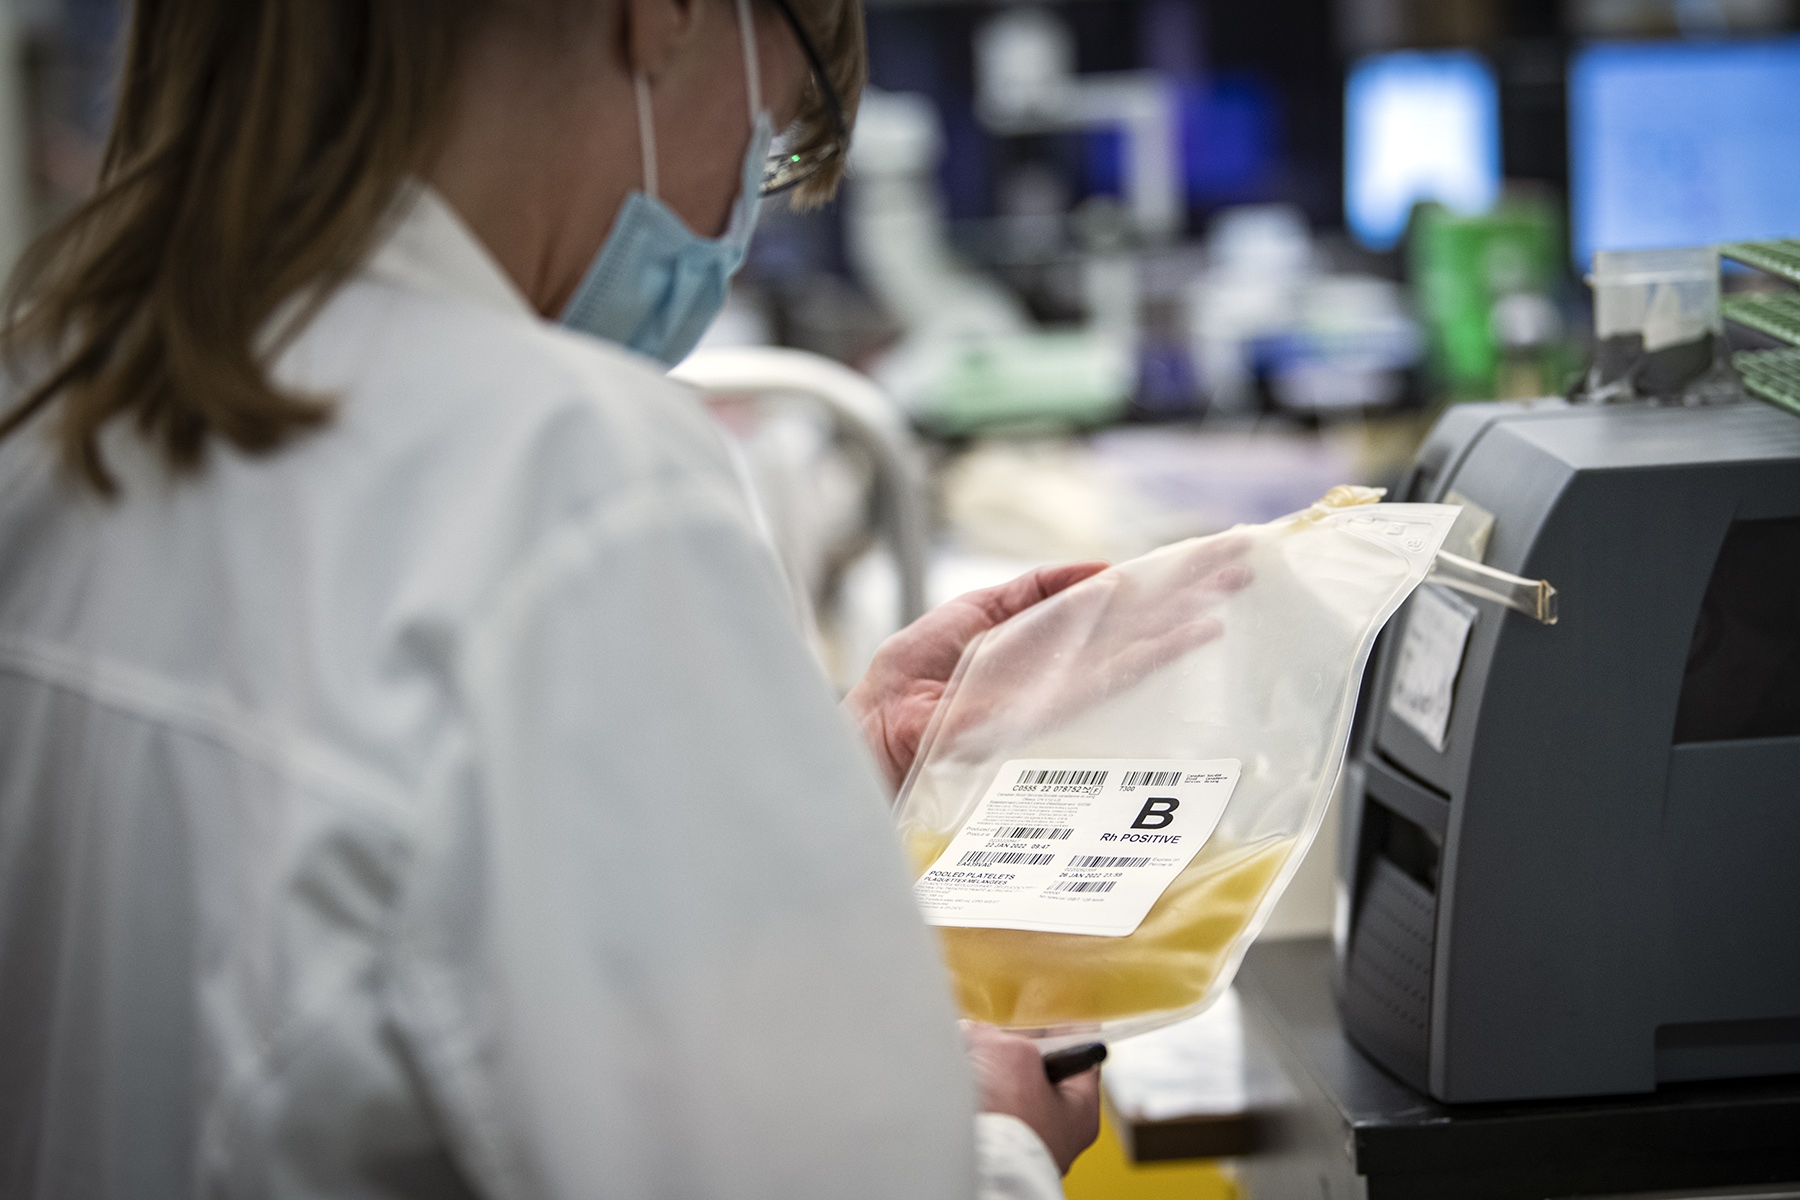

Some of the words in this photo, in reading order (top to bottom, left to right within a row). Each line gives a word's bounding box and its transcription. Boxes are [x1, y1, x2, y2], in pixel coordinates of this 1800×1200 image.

[1053, 785, 1081, 793] 078752
[1130, 797, 1180, 829] B
[1100, 833, 1118, 842] Rh
[1120, 833, 1182, 844] POSITIVE
[929, 870, 965, 878] POOLED
[965, 872, 1016, 880] PLATELETS
